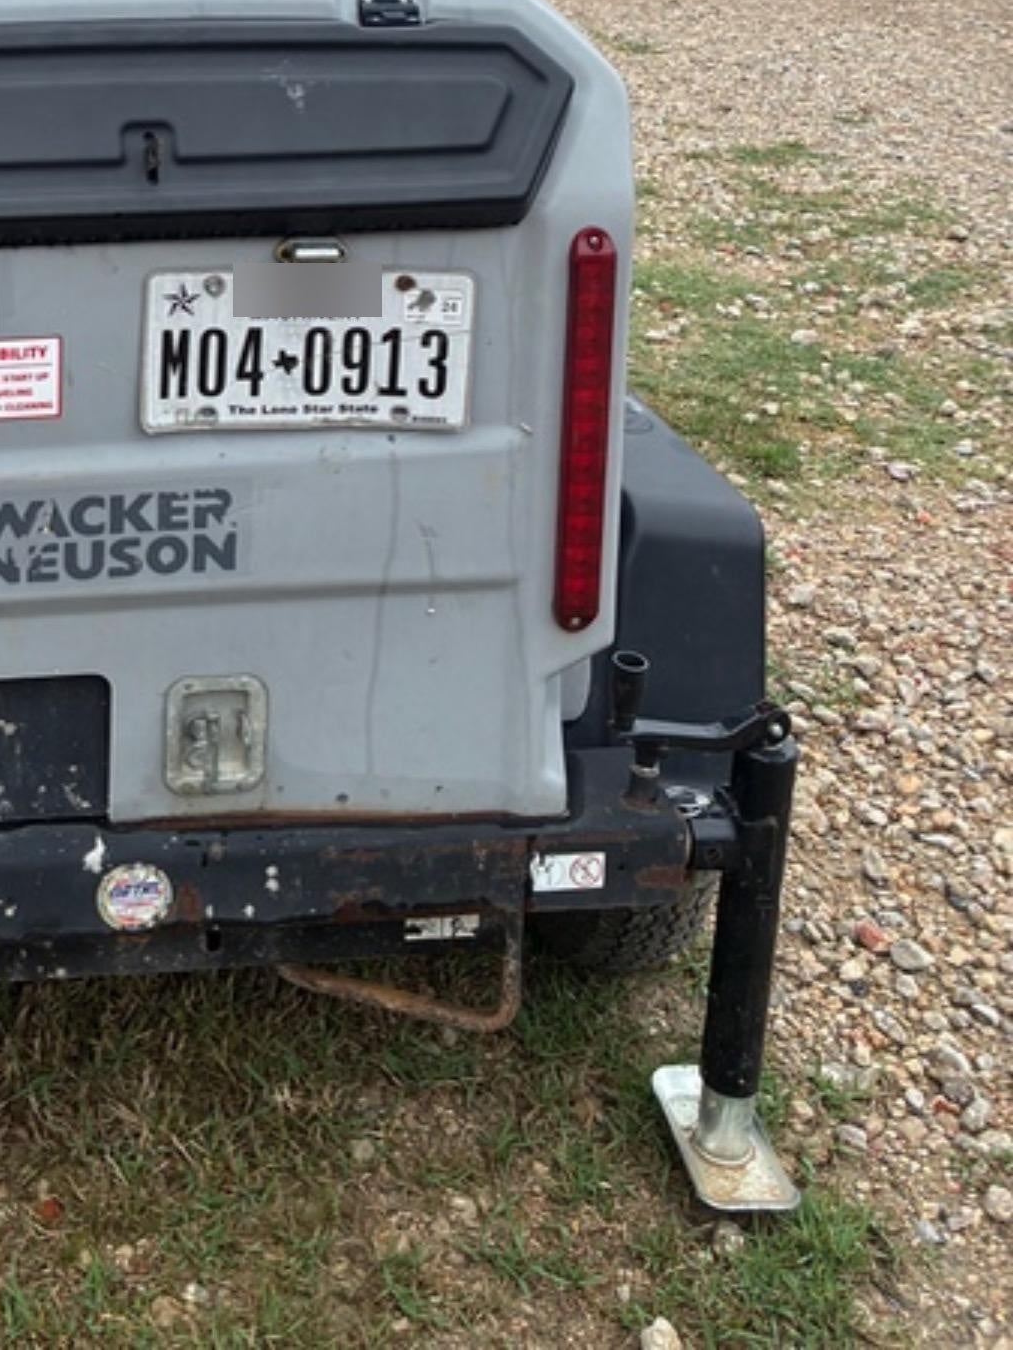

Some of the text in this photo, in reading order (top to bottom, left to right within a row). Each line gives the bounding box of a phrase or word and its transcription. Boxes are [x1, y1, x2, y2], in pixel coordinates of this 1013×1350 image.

[301, 325, 450, 399] 0913
[229, 402, 379, 415] The Lone Star State
